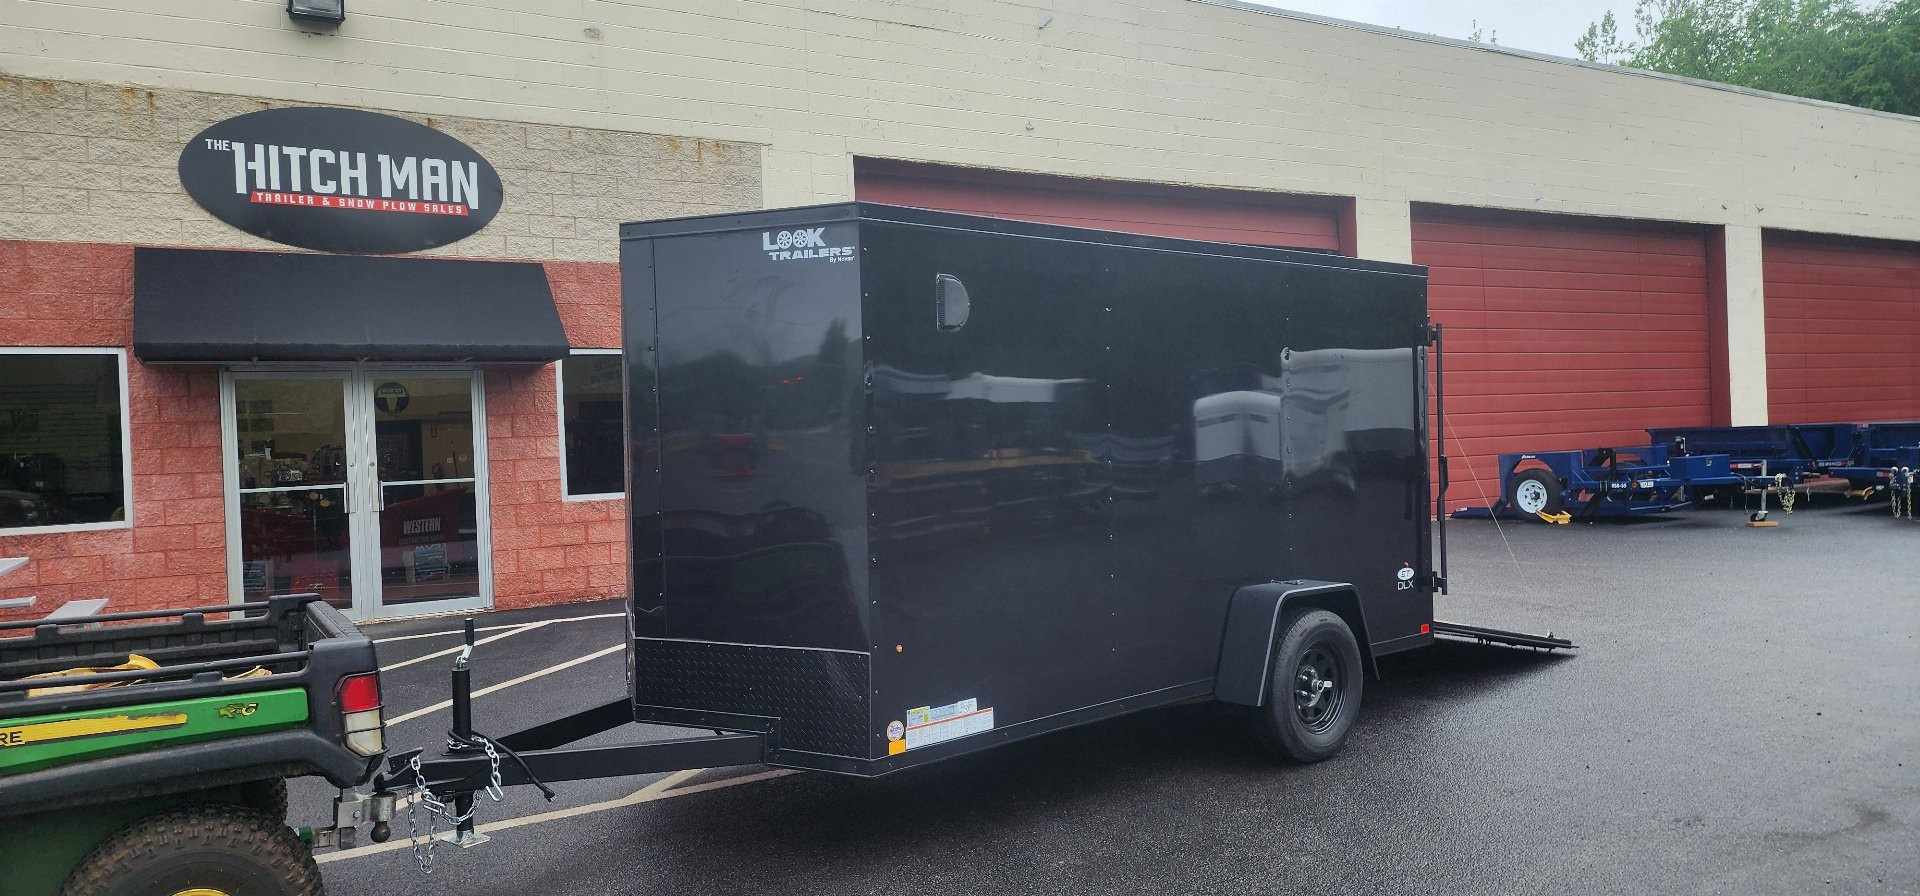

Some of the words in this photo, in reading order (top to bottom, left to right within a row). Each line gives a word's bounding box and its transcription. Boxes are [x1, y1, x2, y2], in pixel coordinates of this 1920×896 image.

[205, 139, 231, 151] THE
[231, 141, 368, 196] HITCH
[377, 153, 479, 210] MAN
[256, 192, 314, 205] TRAILER
[322, 197, 331, 206] &
[339, 197, 375, 209] SNOW
[382, 201, 417, 211] PLOW
[424, 204, 462, 214] SALES
[763, 227, 826, 251] LOOK
[403, 517, 441, 535] WESTERN
[1398, 580, 1414, 590] DLX
